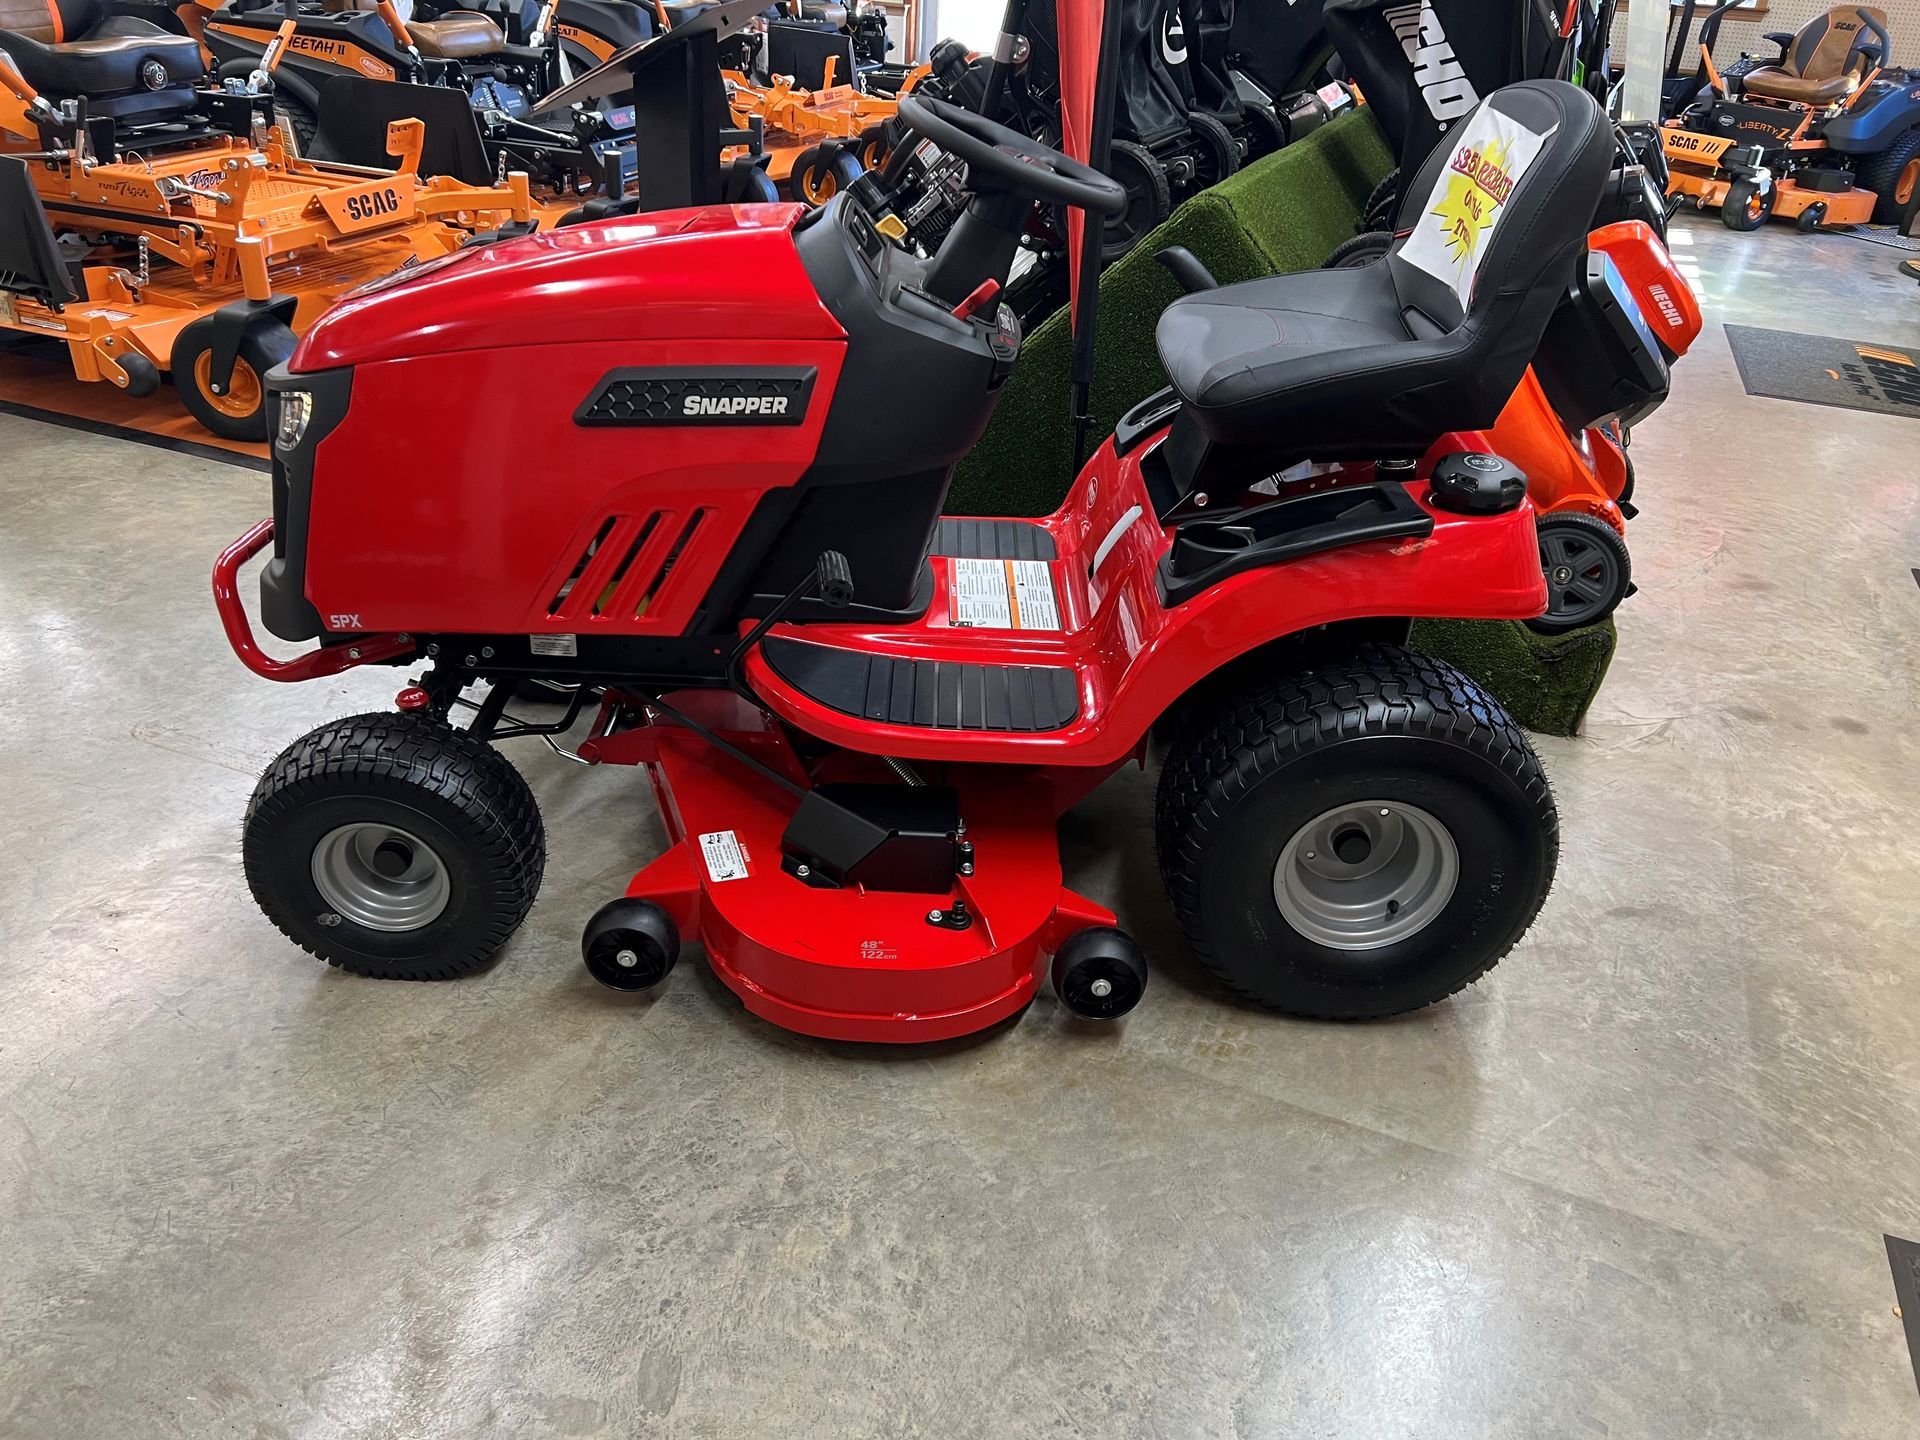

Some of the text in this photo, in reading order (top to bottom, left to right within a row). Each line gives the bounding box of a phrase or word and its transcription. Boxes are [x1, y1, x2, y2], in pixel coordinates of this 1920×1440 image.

[1669, 135, 1699, 150] SCAG
[347, 189, 398, 220] SCAG
[1651, 284, 1683, 327] ECHO
[683, 395, 788, 416] SNAPPER
[330, 614, 362, 628] SPX
